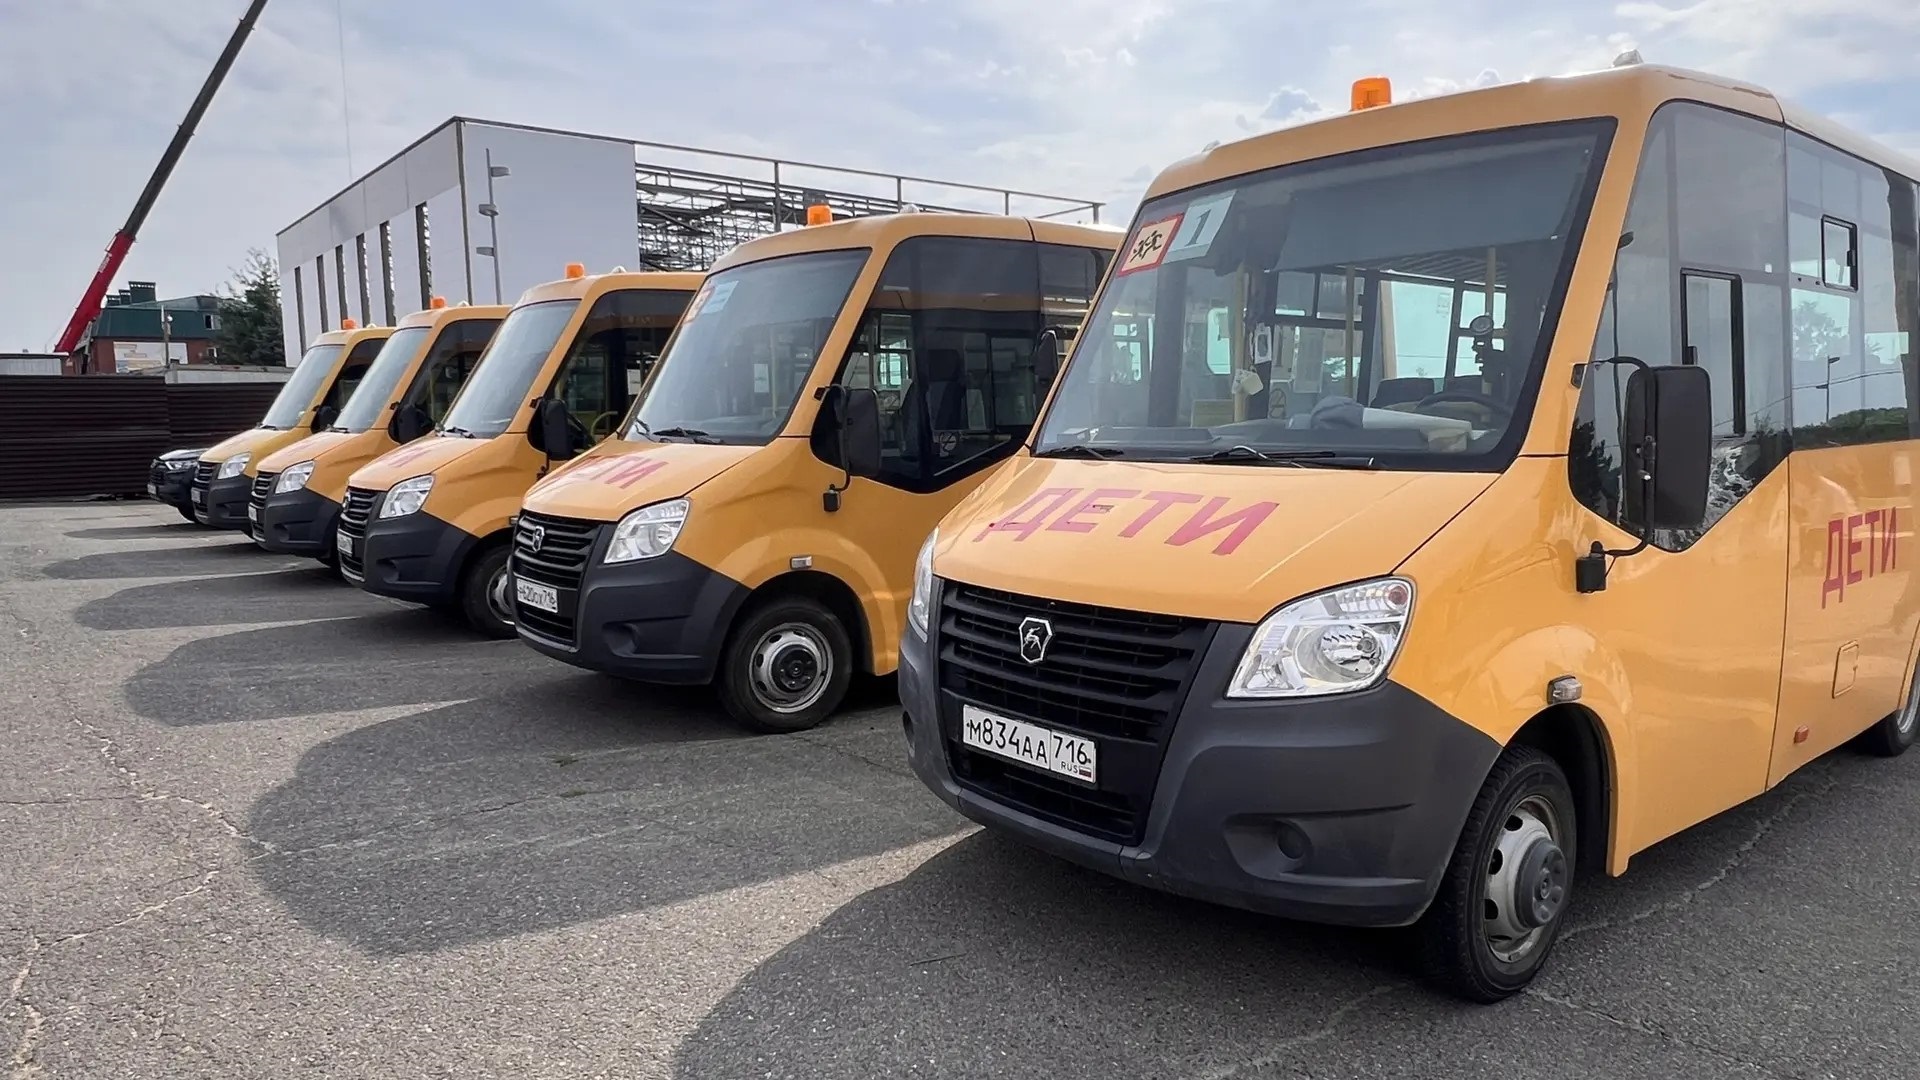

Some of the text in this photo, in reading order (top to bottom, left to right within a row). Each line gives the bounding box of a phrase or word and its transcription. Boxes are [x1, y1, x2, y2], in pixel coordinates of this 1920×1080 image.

[1185, 209, 1212, 247] 1
[973, 488, 1279, 555] ДЕТИ
[1821, 506, 1896, 610] ДЕТИ
[968, 718, 1088, 765] М834АА 716
[1060, 761, 1079, 774] RUS
